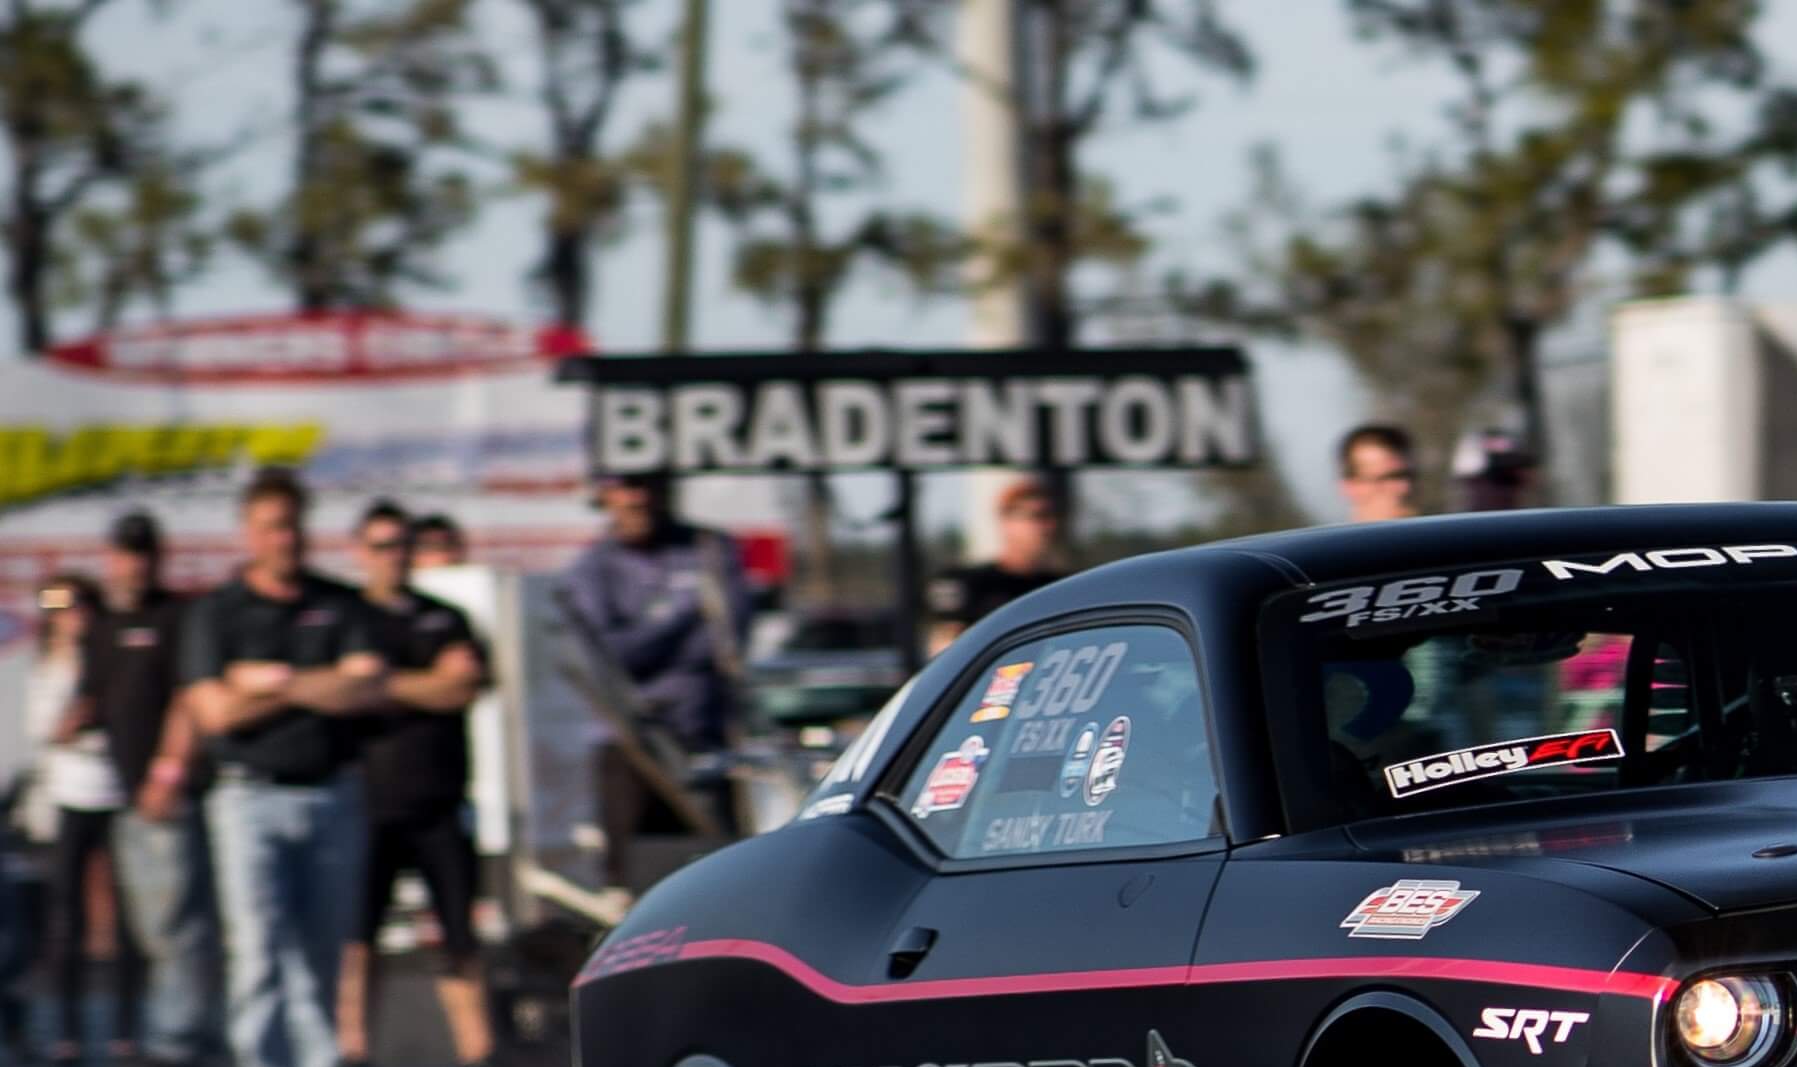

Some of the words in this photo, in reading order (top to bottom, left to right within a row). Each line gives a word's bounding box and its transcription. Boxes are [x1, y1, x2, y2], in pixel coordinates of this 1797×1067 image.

[601, 377, 1254, 472] BRADENTON
[1300, 569, 1523, 623] 360
[1346, 597, 1481, 628] FS/XX
[1016, 642, 1128, 719] 360
[1391, 746, 1528, 789] Holley
[1052, 809, 1114, 847] TURK
[1377, 889, 1451, 914] BES
[1472, 1007, 1590, 1055] SRT
